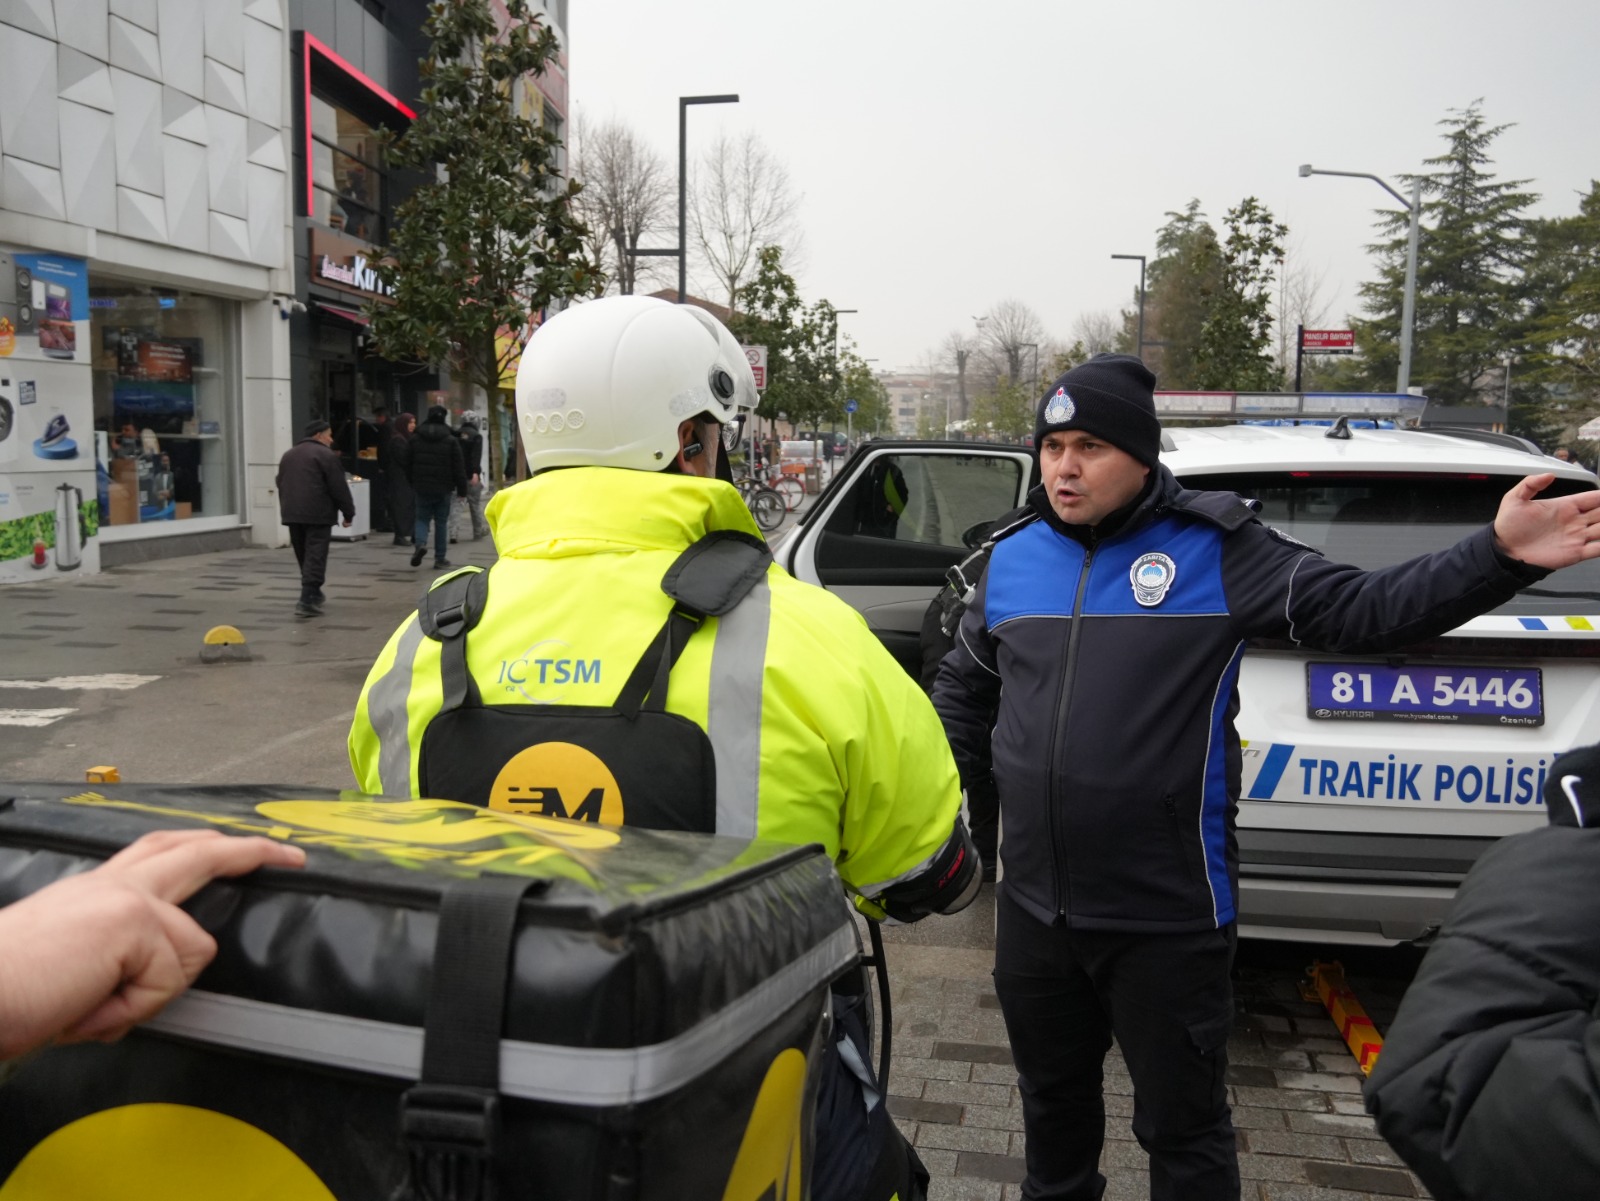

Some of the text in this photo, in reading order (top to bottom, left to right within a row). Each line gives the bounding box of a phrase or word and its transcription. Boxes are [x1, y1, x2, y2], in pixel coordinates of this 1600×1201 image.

[534, 658, 601, 685] TSM
[1331, 671, 1534, 710] 81 A 5446
[1333, 710, 1375, 719] HYUNDAI
[1499, 715, 1537, 726] Özenler
[1299, 753, 1547, 806] TRAFİK POLİSİ
